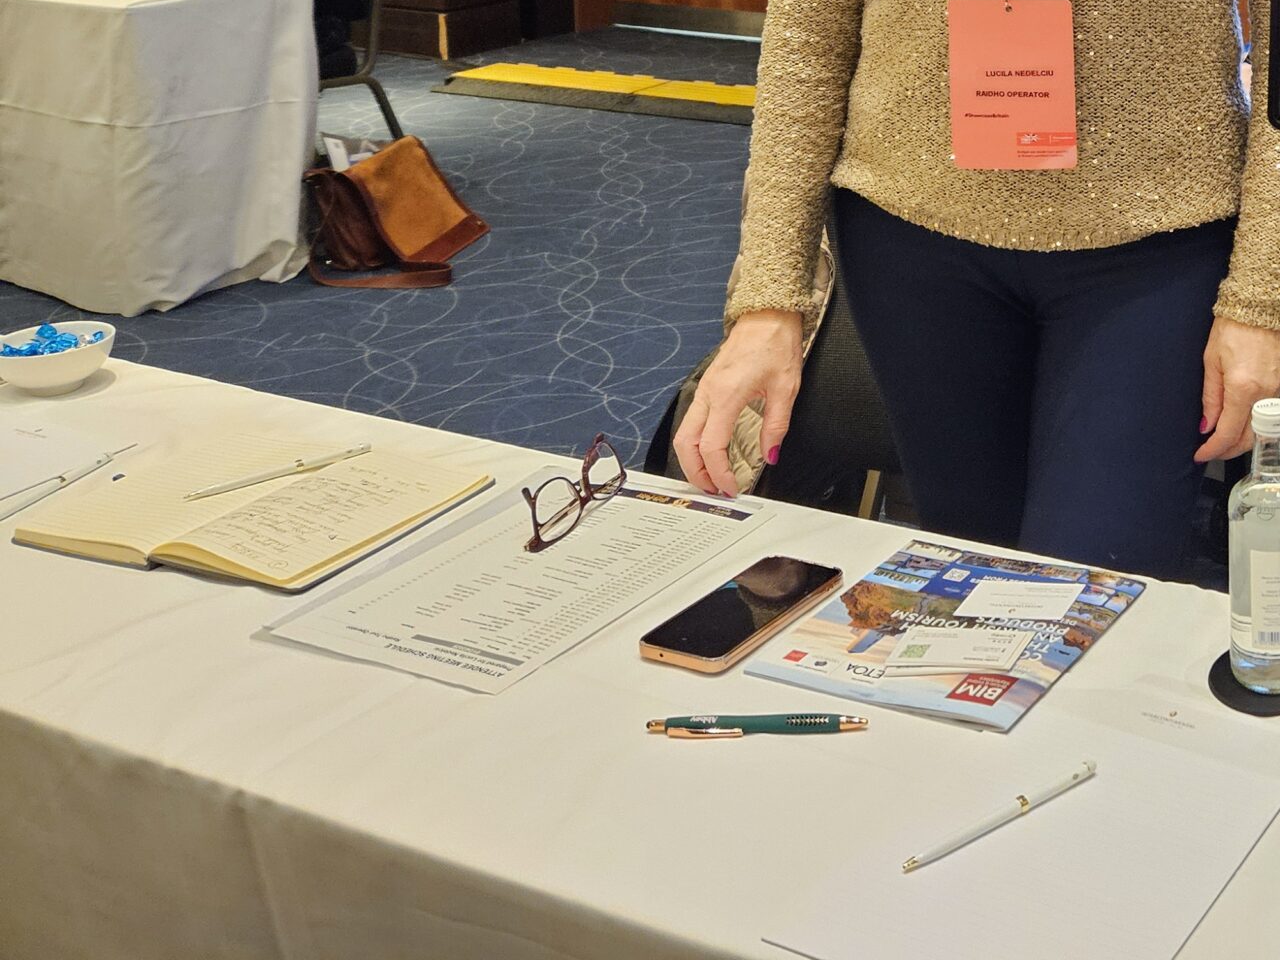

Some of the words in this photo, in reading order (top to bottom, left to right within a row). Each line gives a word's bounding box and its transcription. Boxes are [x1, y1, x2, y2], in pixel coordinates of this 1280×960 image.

[975, 616, 1070, 636] PRODUCTS
[384, 643, 426, 658] SCHEDULE
[426, 653, 460, 667] MEETING
[486, 660, 512, 671] Prepared
[461, 661, 504, 678] ATTENDEE
[846, 663, 886, 679] ETOA
[955, 682, 1003, 700] BIM
